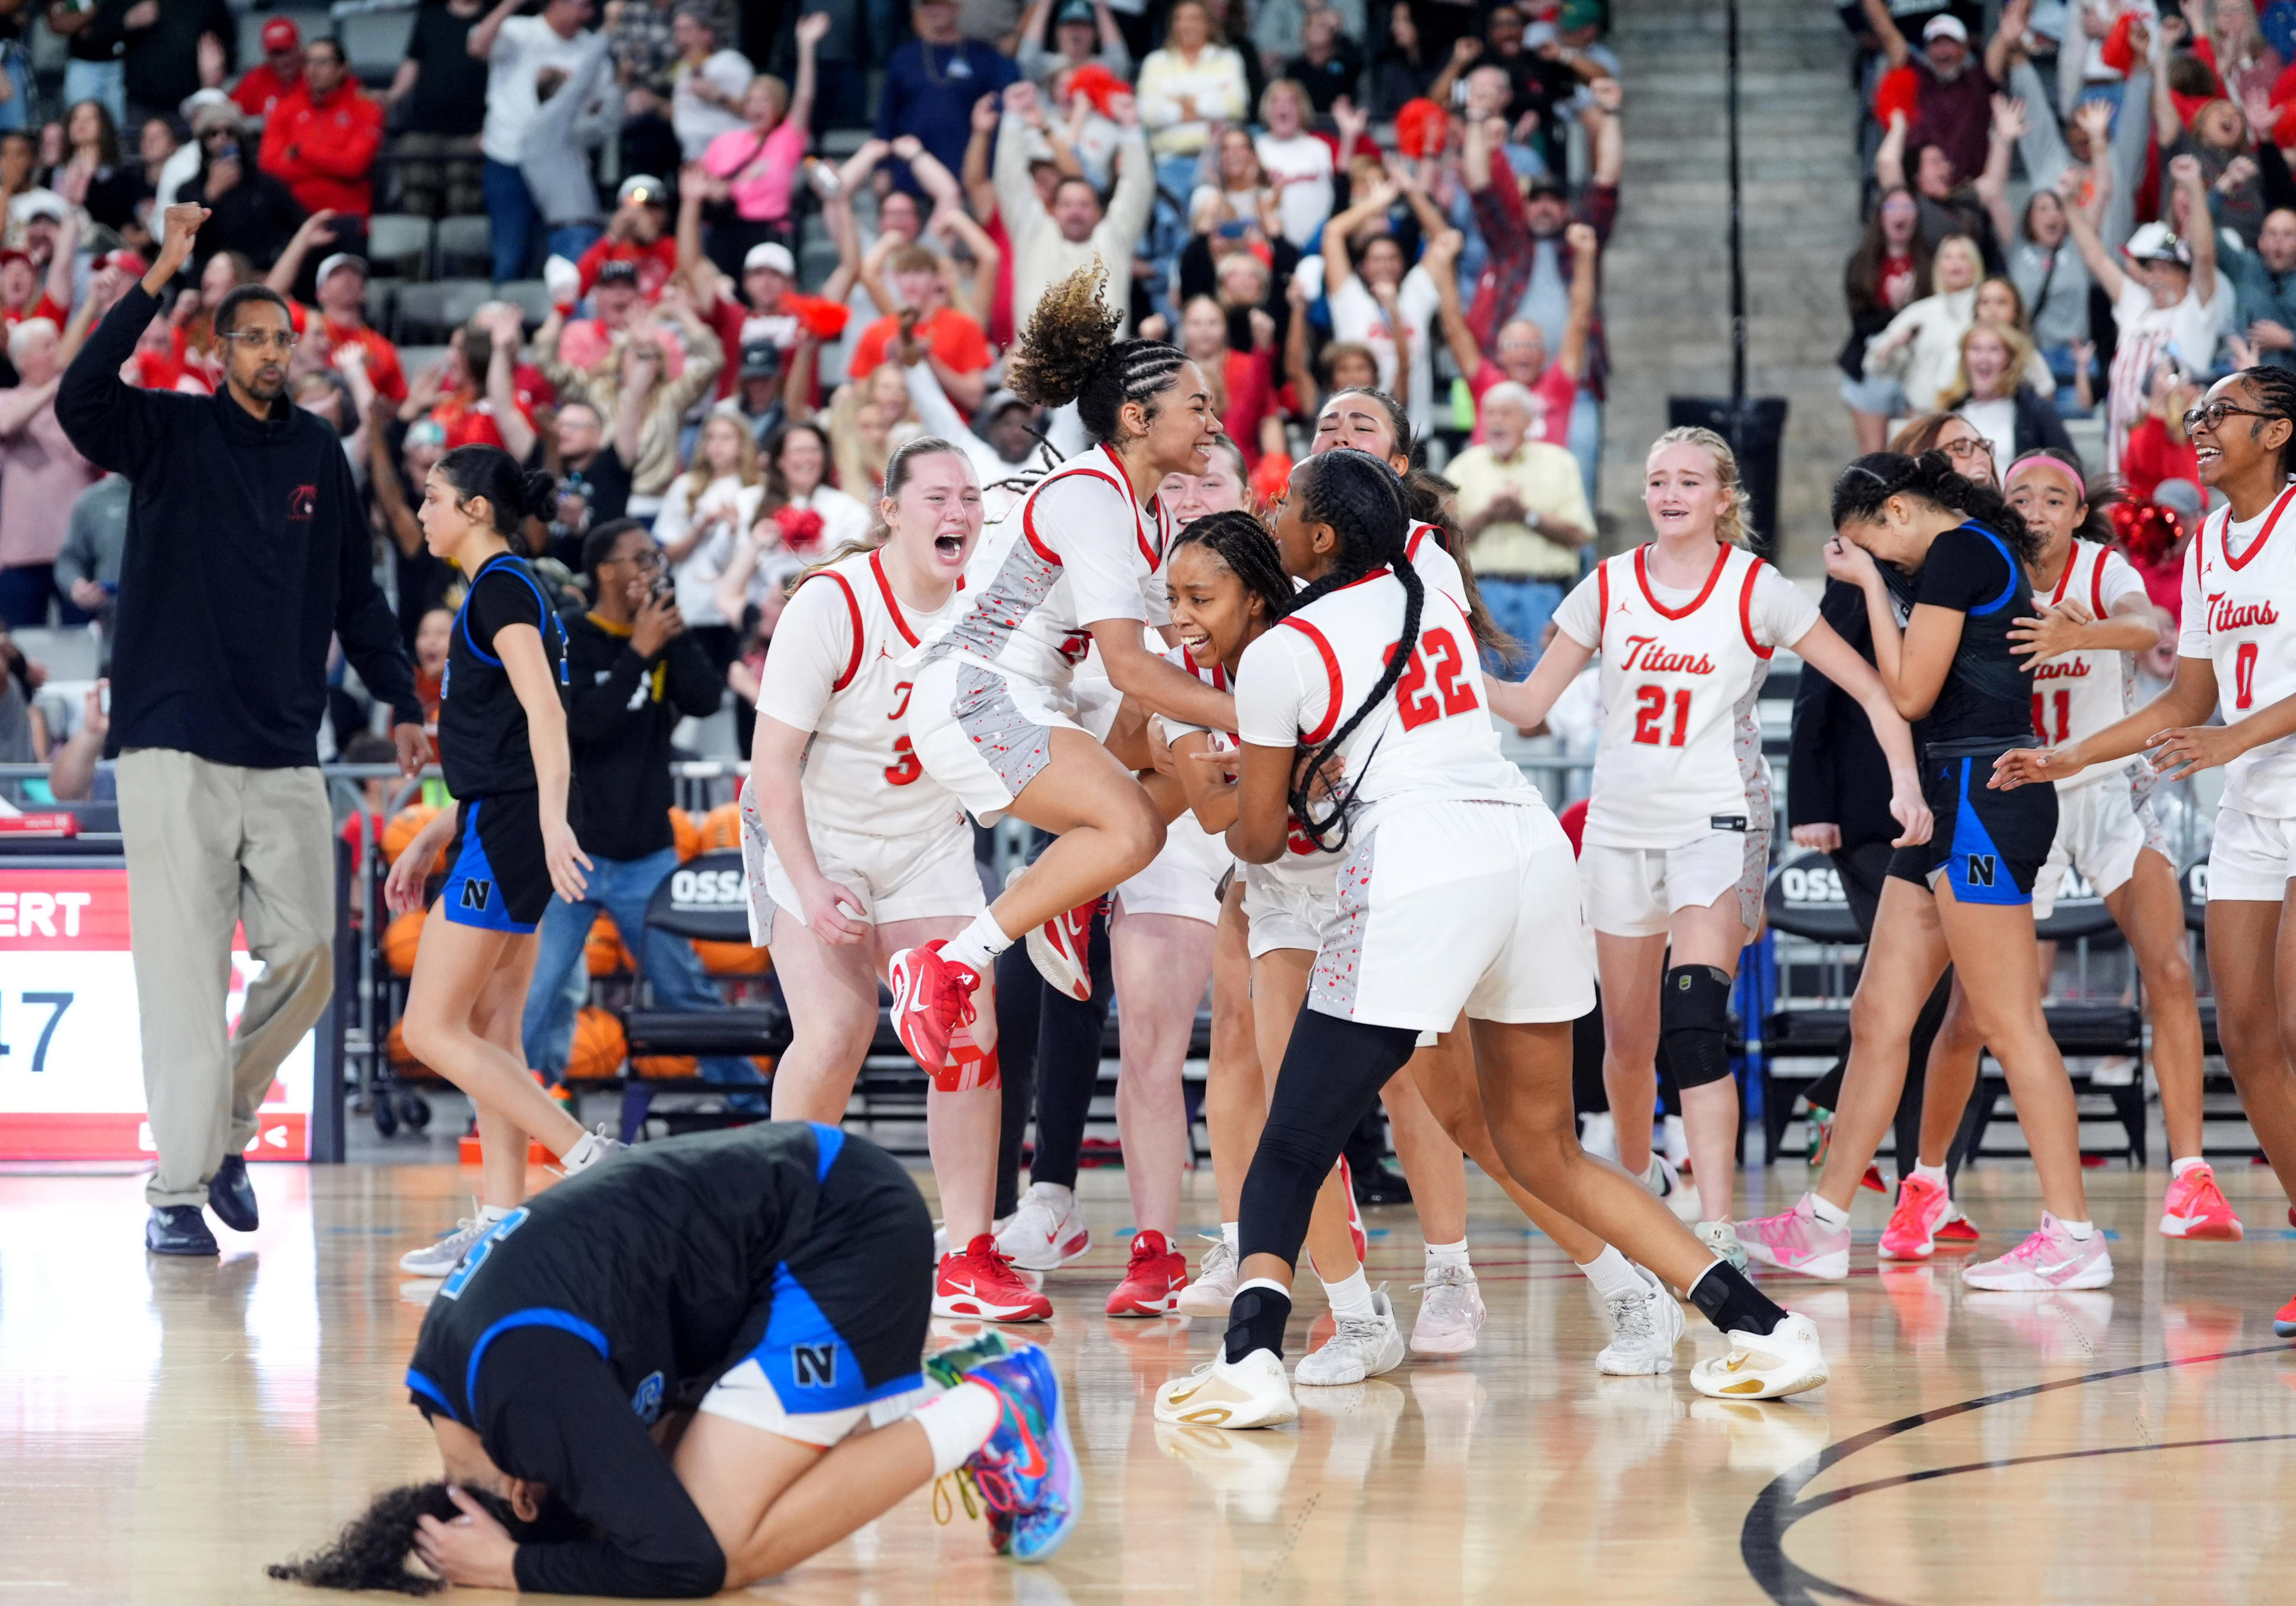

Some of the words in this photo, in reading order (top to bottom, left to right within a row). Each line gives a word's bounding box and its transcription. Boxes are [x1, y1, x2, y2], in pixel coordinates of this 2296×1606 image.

[2207, 590, 2280, 635] Titans
[1621, 635, 1716, 675] Titans
[2235, 640, 2260, 712] 0
[1380, 625, 1480, 734] 22
[1631, 683, 1693, 749] 21
[1968, 853, 1996, 887] N
[460, 876, 492, 913] N
[790, 1342, 839, 1388] N
